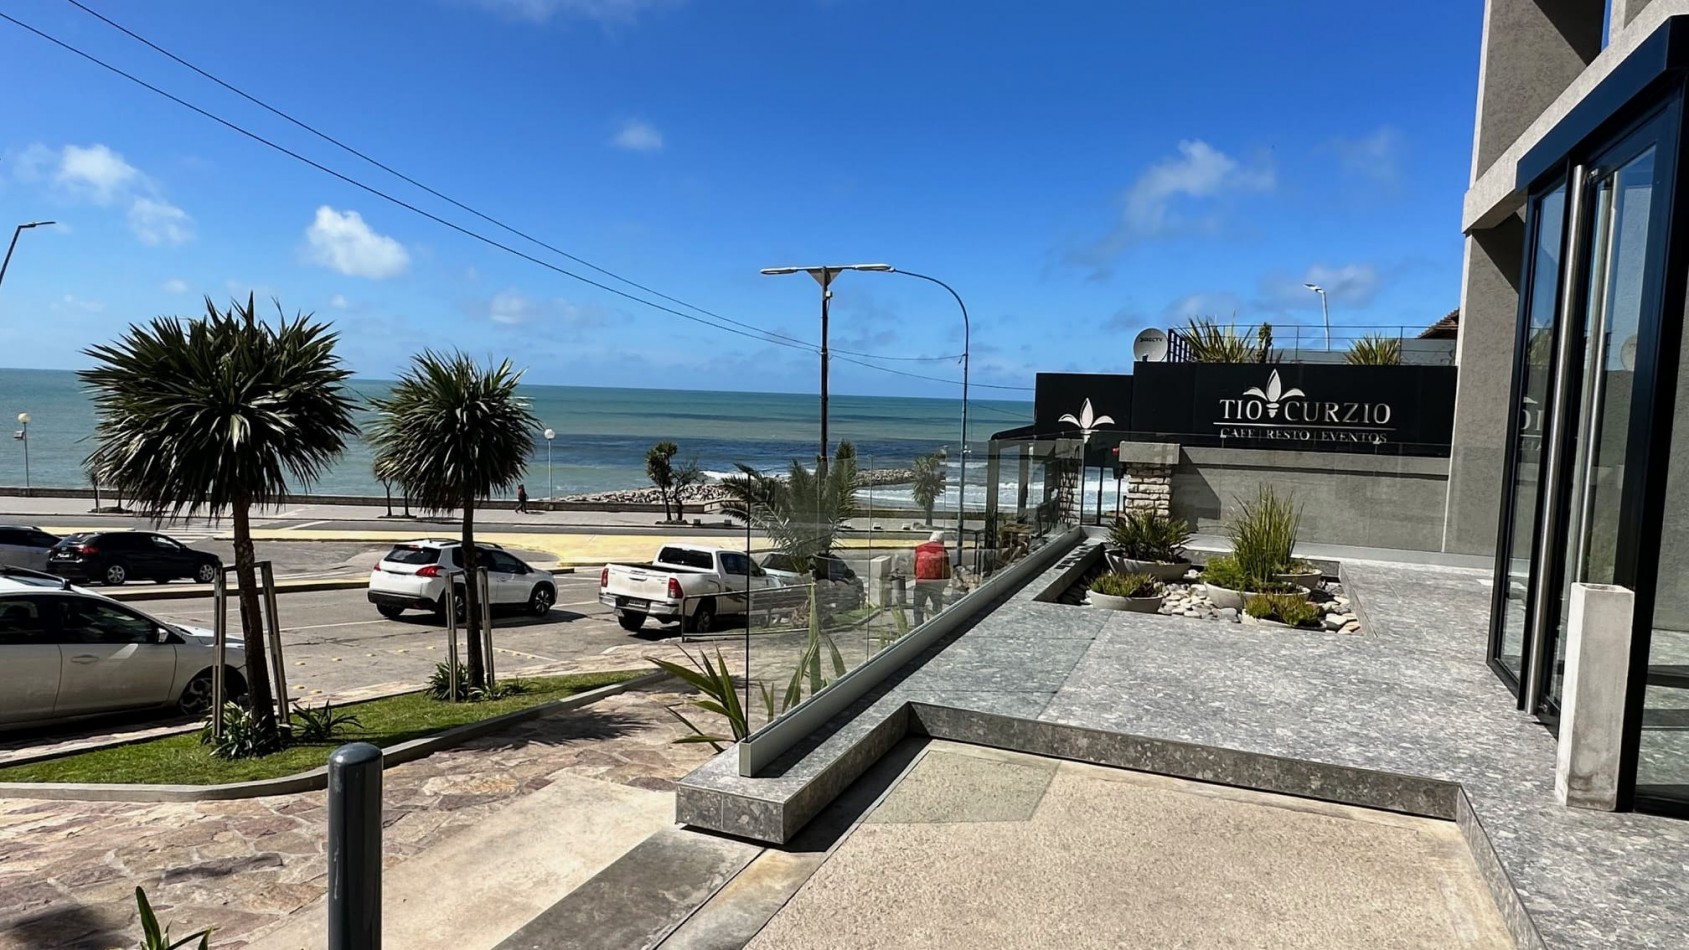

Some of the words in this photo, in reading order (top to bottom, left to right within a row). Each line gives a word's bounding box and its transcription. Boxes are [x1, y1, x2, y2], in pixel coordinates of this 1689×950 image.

[1219, 399, 1263, 421] TIO
[1284, 401, 1391, 424] CURZIO
[1266, 429, 1310, 441] RESTO
[1321, 431, 1387, 444] EVENTOS
